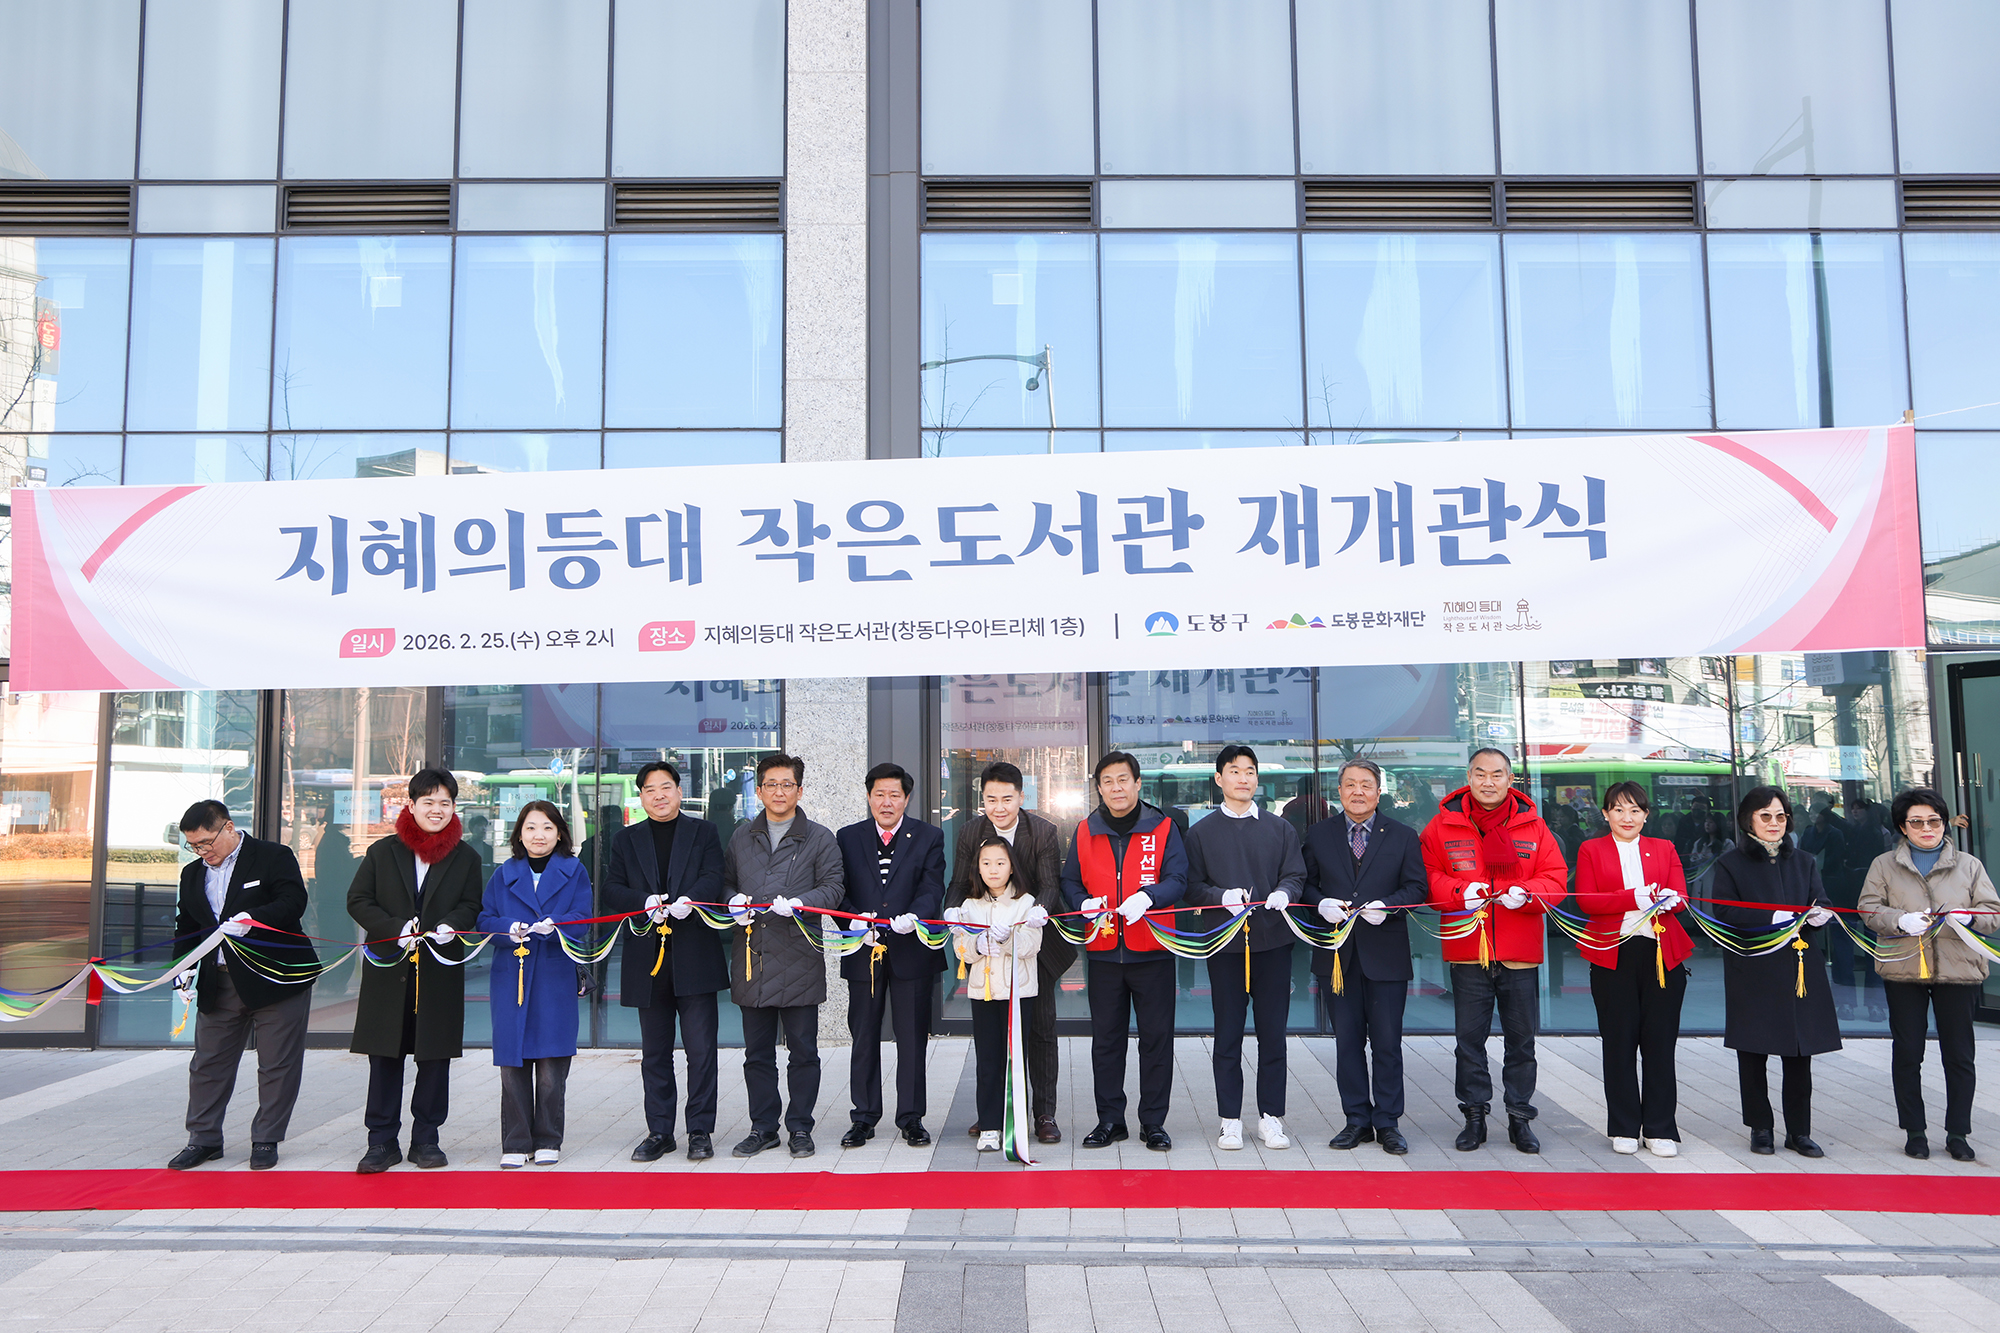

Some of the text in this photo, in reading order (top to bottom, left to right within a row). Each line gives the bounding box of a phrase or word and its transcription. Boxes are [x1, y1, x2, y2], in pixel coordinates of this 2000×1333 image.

[275, 474, 1607, 596] 지혜의등대 작은도서관 재개관식
[1443, 600, 1502, 613] 지혜의 등대
[1187, 612, 1250, 633] 도봉구
[1330, 610, 1427, 630] 도봉문화재단
[1443, 622, 1503, 633] 작은도서관
[402, 628, 615, 651] 2026. 2. 25.(수) 오후 2시
[649, 626, 687, 648] 장소
[704, 616, 1085, 645] 지혜의등대 작은도서관(창동다우아트리체 1층)
[350, 633, 385, 653] 일시
[703, 719, 722, 731] 일시
[730, 721, 758, 730] 2026.
[1126, 715, 1156, 724] 도봉구
[1194, 714, 1241, 723] 도봉문화재단
